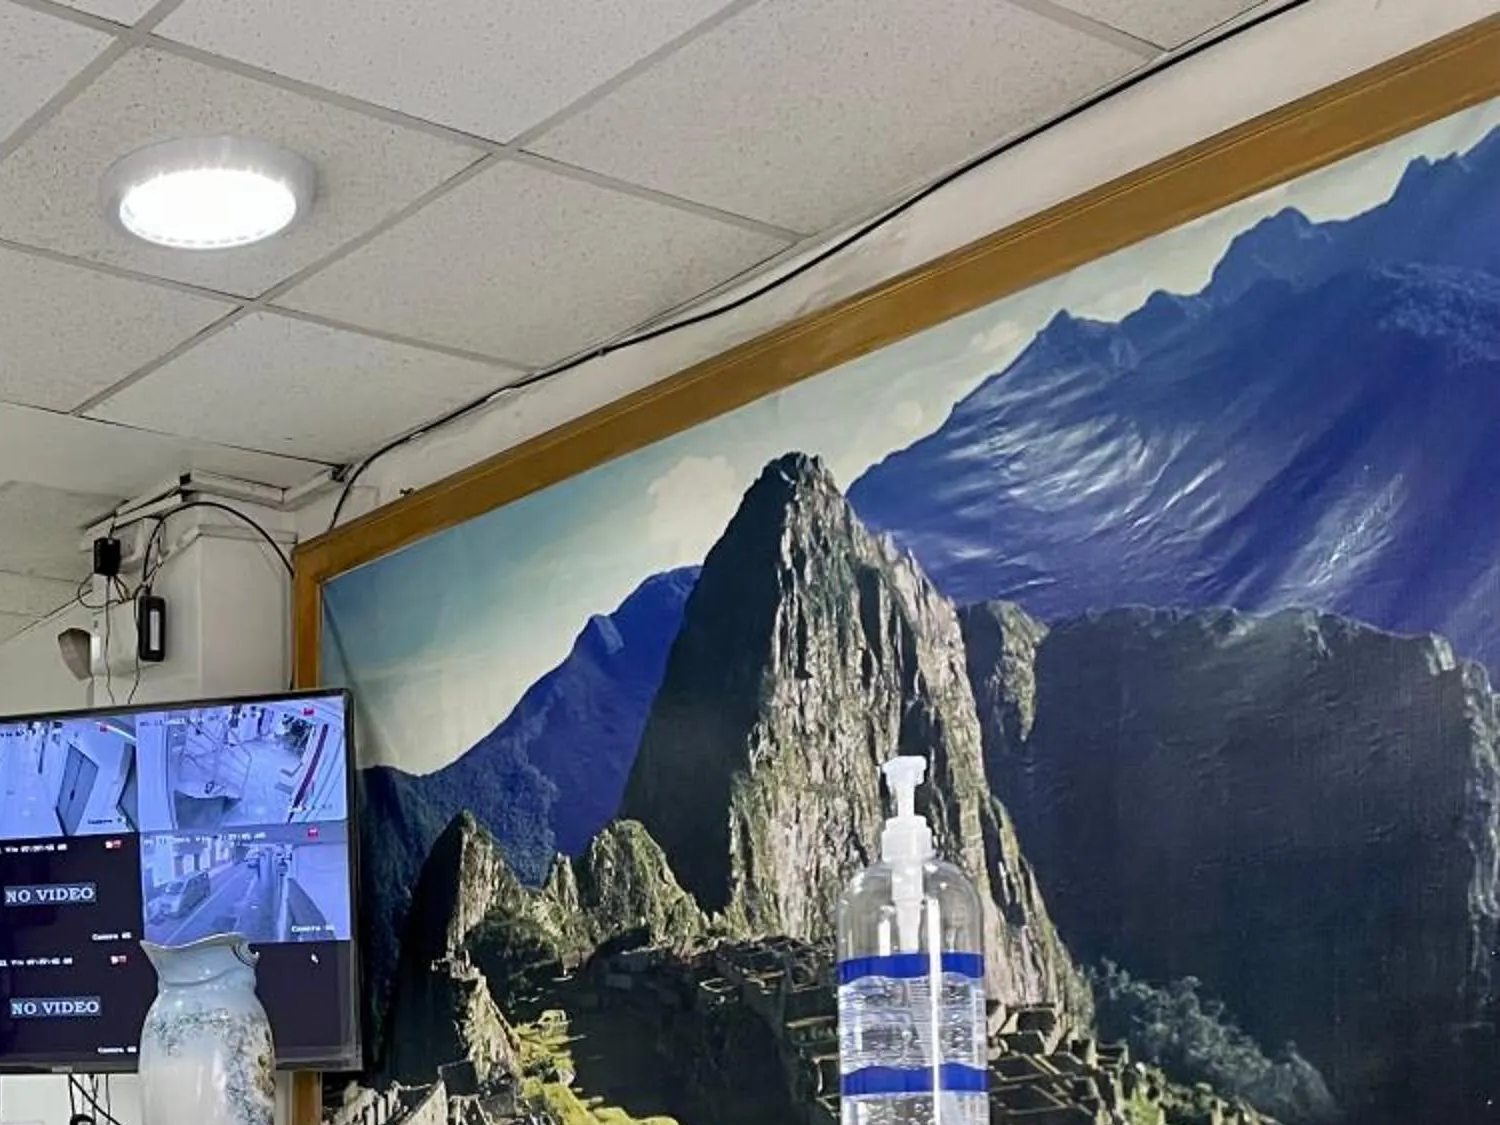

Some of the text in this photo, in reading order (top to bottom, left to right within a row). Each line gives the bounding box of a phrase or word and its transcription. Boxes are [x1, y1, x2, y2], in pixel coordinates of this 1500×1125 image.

[5, 886, 94, 904] NO VIDEO
[11, 1000, 100, 1016] NO VIDEO
